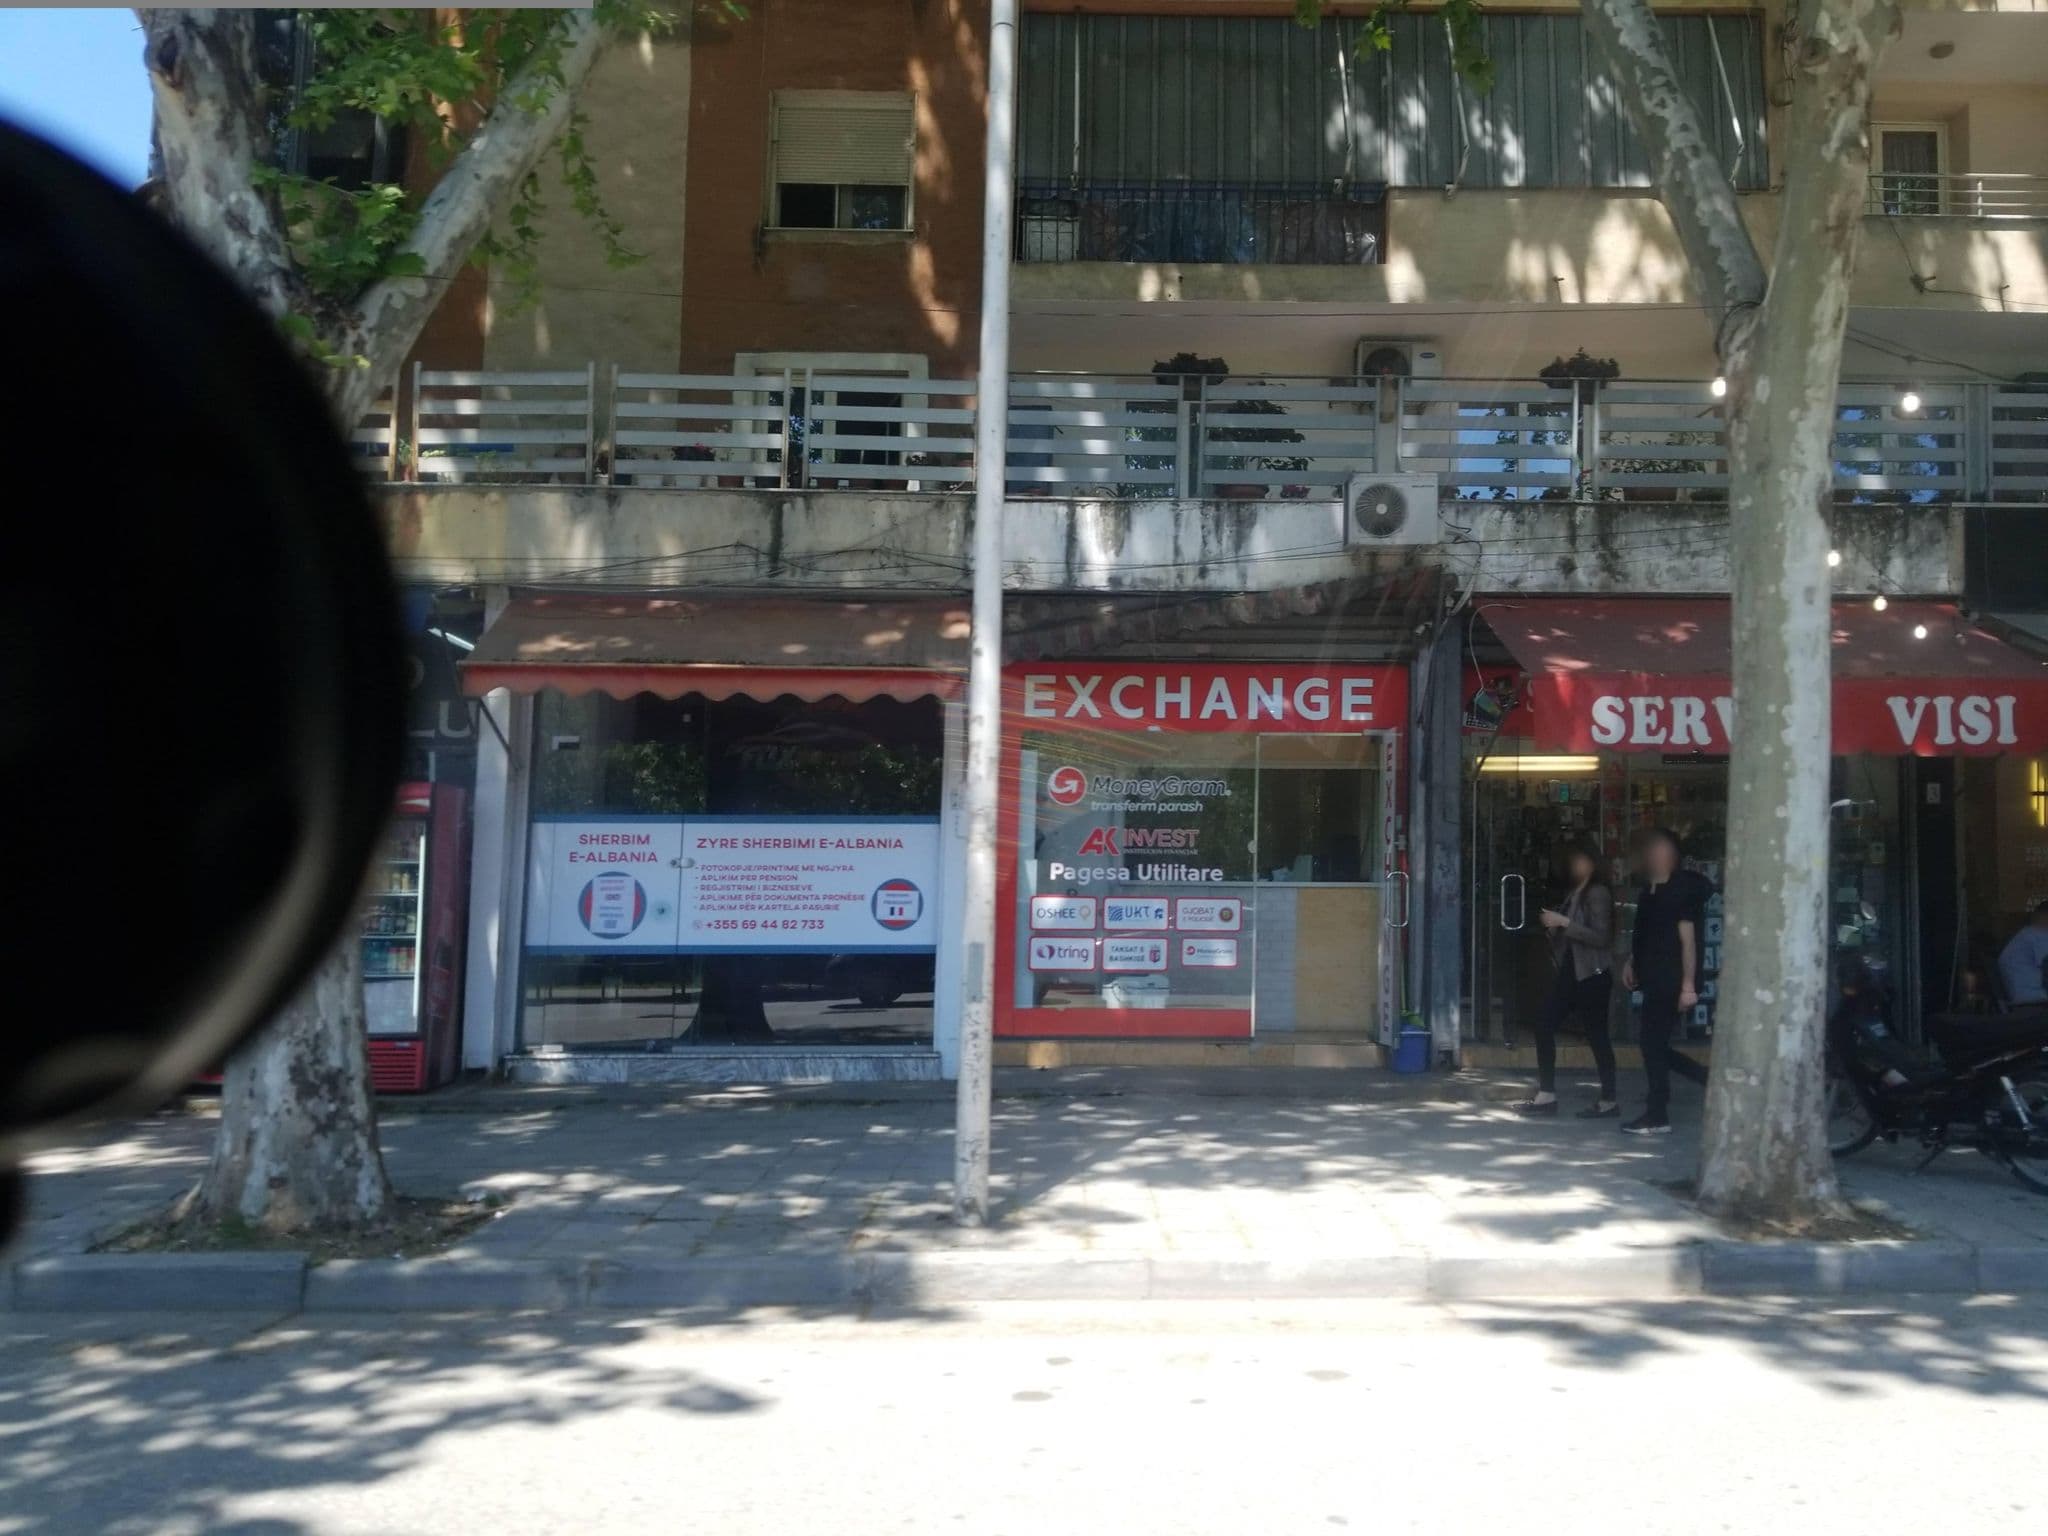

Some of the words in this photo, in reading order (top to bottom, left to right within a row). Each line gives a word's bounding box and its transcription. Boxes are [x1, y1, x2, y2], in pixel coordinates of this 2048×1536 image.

[1023, 673, 1374, 722] EXCHANGE
[1886, 695, 2018, 745] VISI
[1091, 801, 1156, 812] transferim
[1157, 801, 1203, 814] parash
[579, 834, 650, 845] SHERBIM
[697, 838, 739, 848] ZYRE
[742, 838, 815, 848] SHERBIMI
[819, 838, 904, 849] E-ALBANIA
[1124, 828, 1200, 848] INVEST
[569, 852, 658, 862] E-ALBANIA
[1050, 862, 1130, 885] Pagesa
[1138, 863, 1223, 881] Utilitare
[1036, 908, 1076, 919] OSHEE
[1124, 906, 1150, 918] UKT
[706, 920, 738, 930] +355
[742, 920, 757, 930] 69
[761, 920, 778, 930] 44
[782, 920, 798, 930] 82
[801, 920, 824, 930] 733
[1057, 946, 1089, 961] tring
